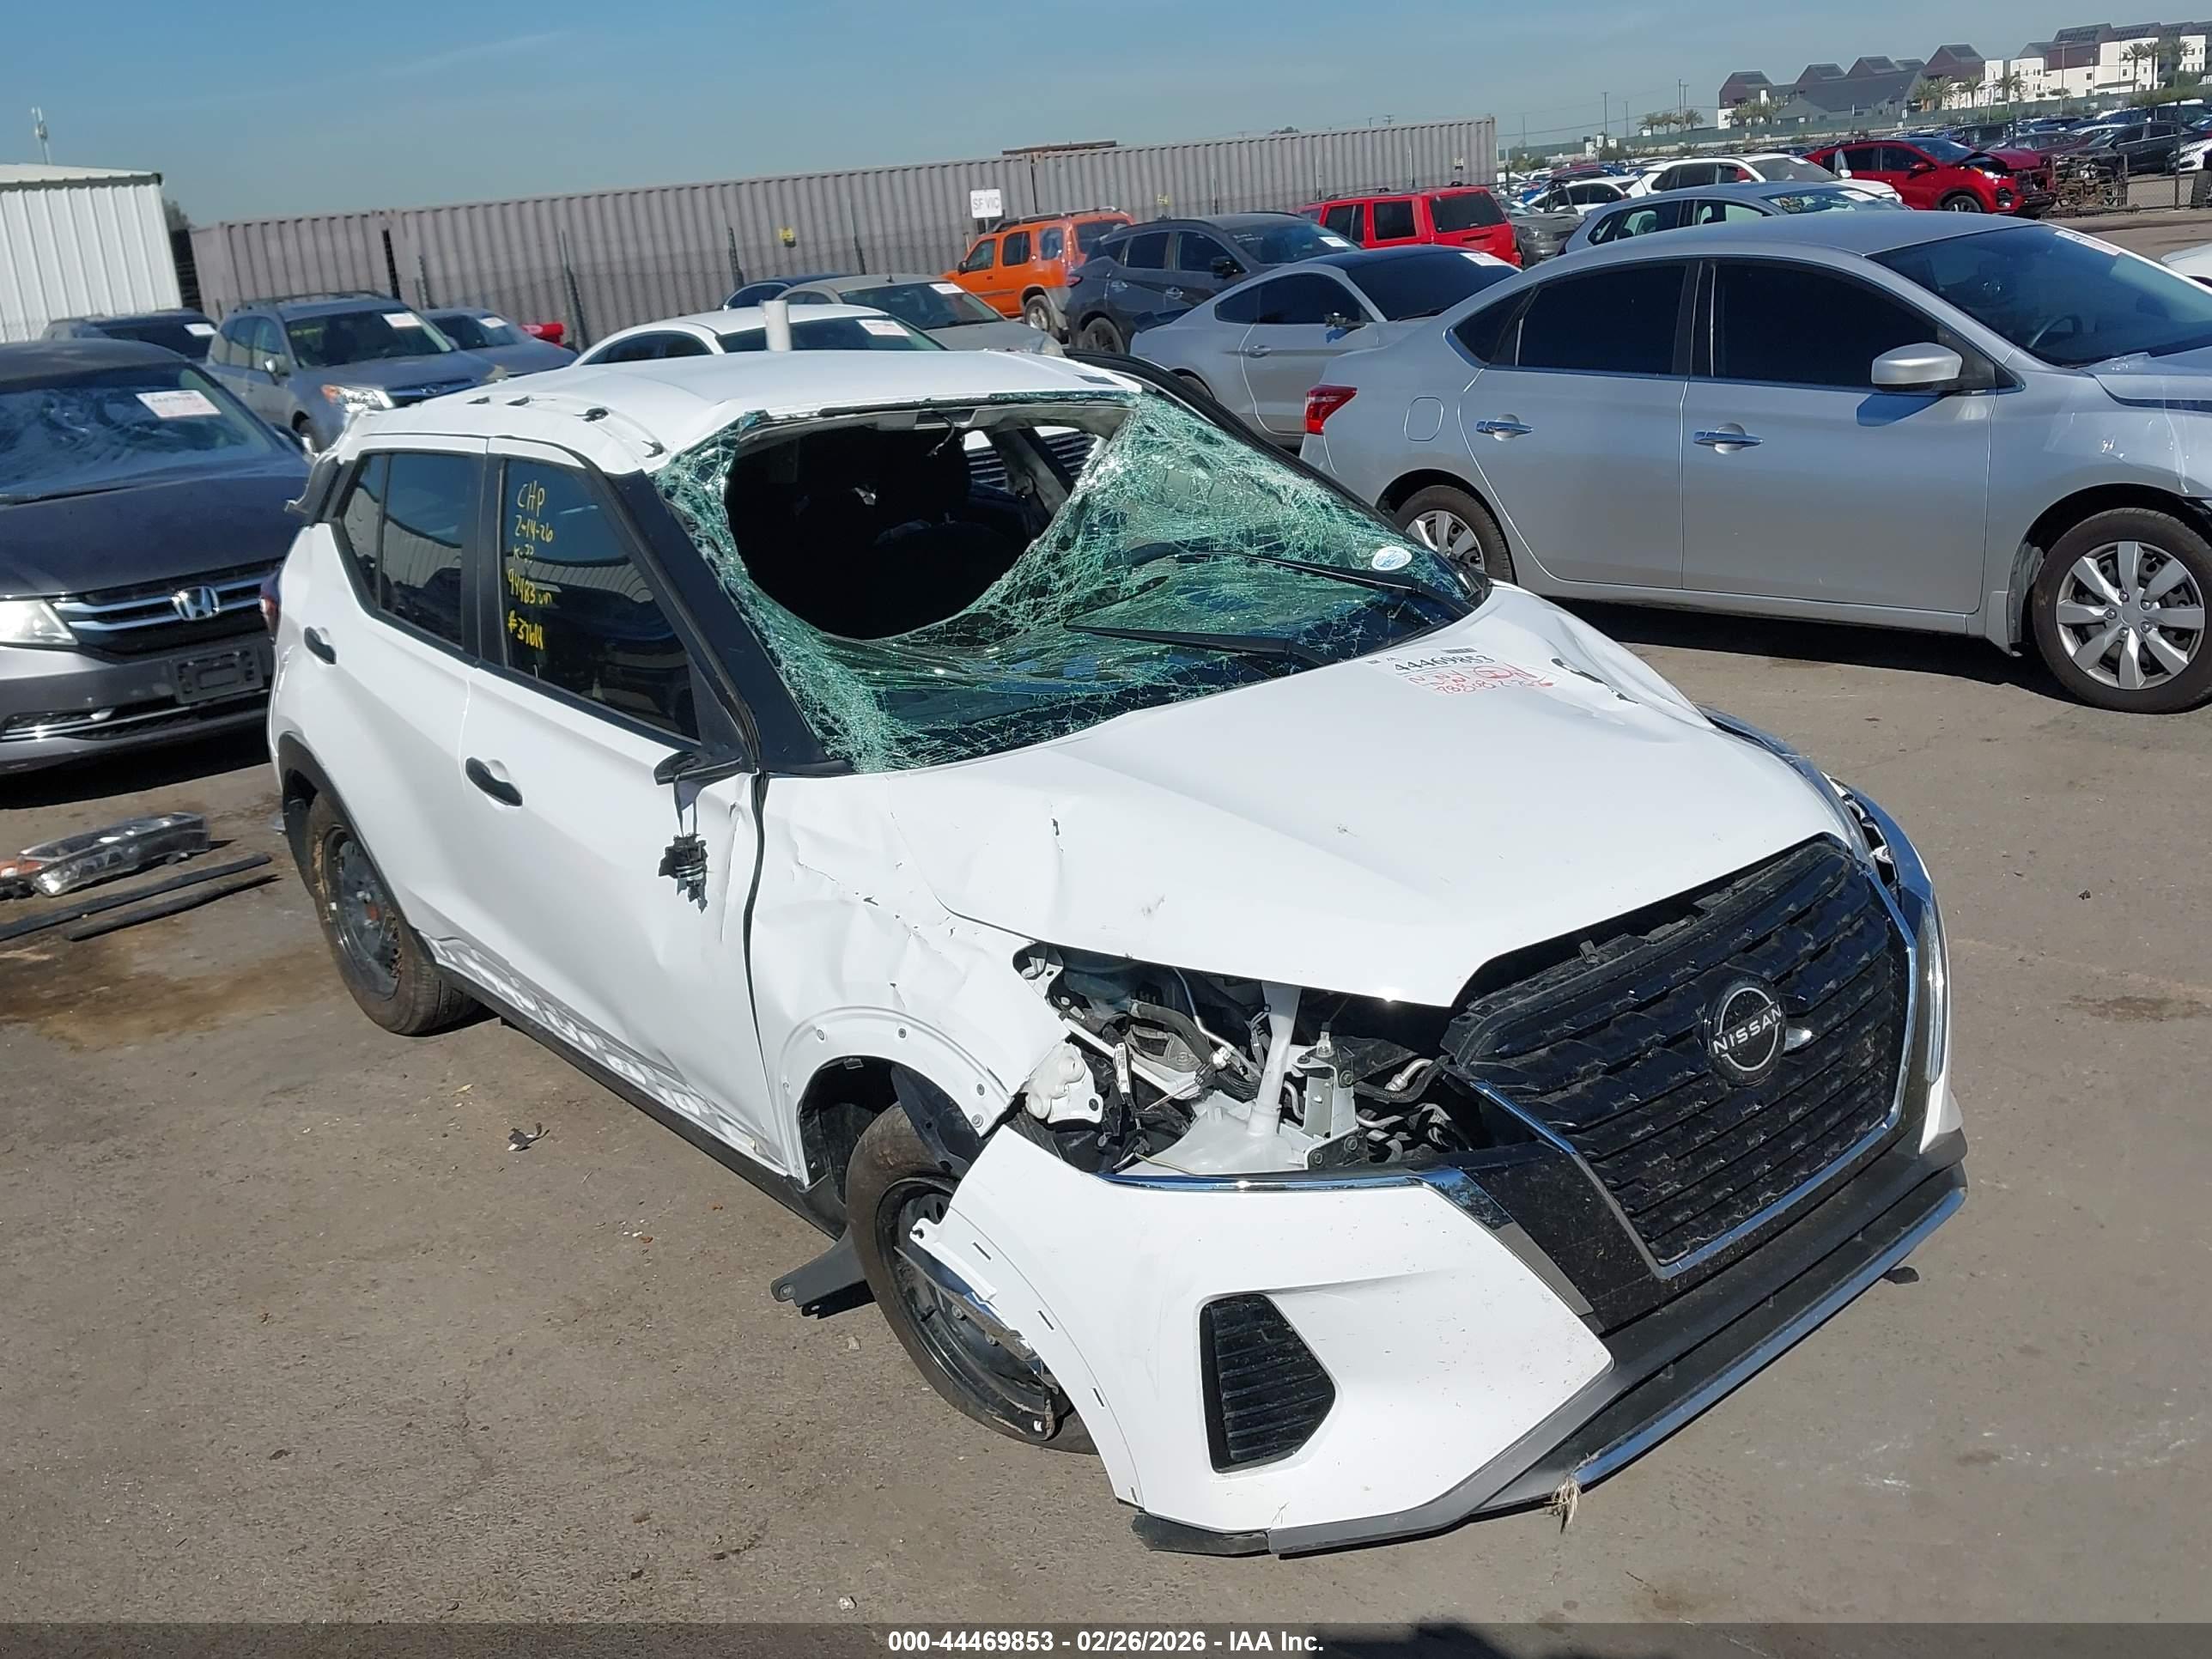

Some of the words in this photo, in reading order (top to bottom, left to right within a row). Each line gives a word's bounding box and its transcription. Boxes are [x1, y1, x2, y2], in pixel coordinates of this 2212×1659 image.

[517, 480, 545, 517] CHP
[514, 514, 554, 543] 2-14-26
[1395, 654, 1496, 672] 44469853
[1712, 1003, 1783, 1054] NISSAN
